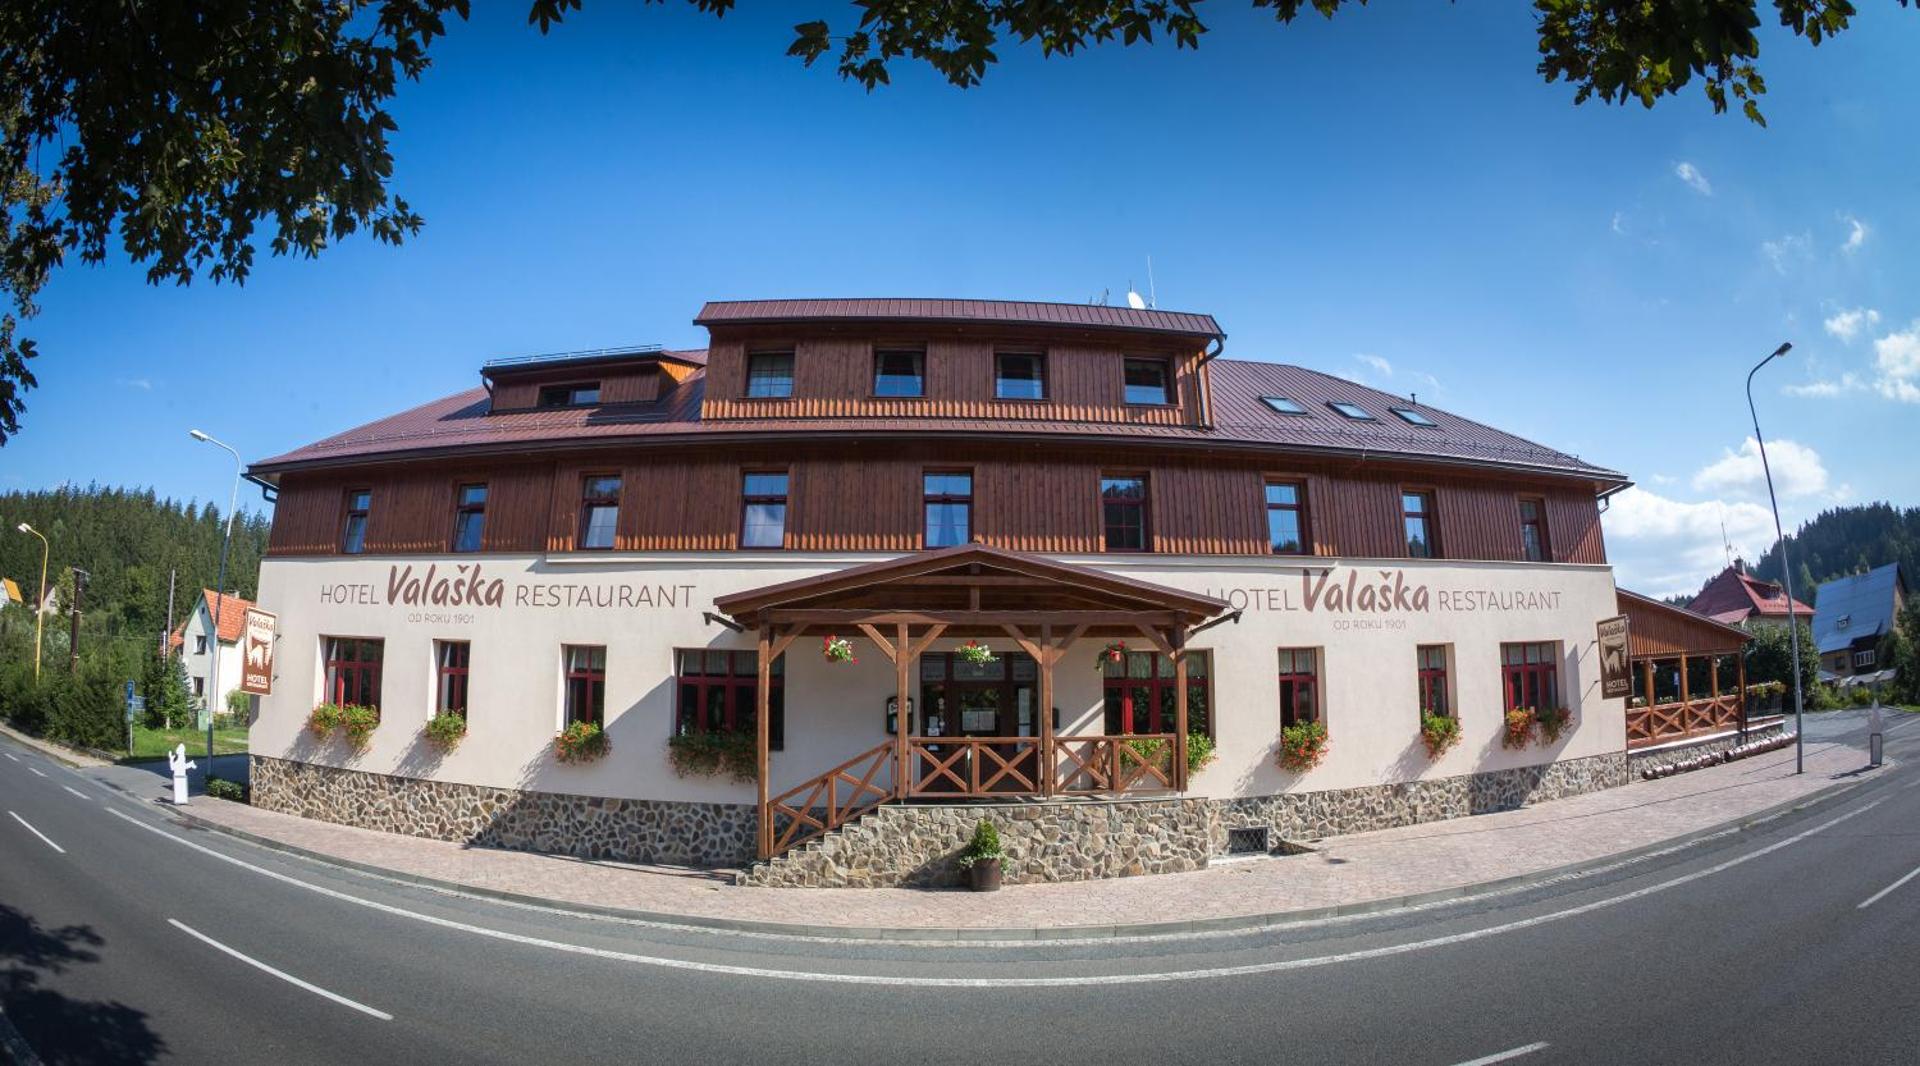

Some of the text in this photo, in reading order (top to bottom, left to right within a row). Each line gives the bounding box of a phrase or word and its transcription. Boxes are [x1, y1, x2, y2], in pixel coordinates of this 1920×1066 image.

[320, 562, 697, 609] HOTEL Valaška RESTAURANT
[1302, 567, 1430, 614] Valaška
[1438, 590, 1562, 612] RESTAURANT
[407, 613, 475, 624] OD ROKU 1901
[1333, 619, 1407, 631] OD ROKU 1901
[247, 674, 268, 683] HOTEL
[1606, 679, 1629, 688] HOTEL
